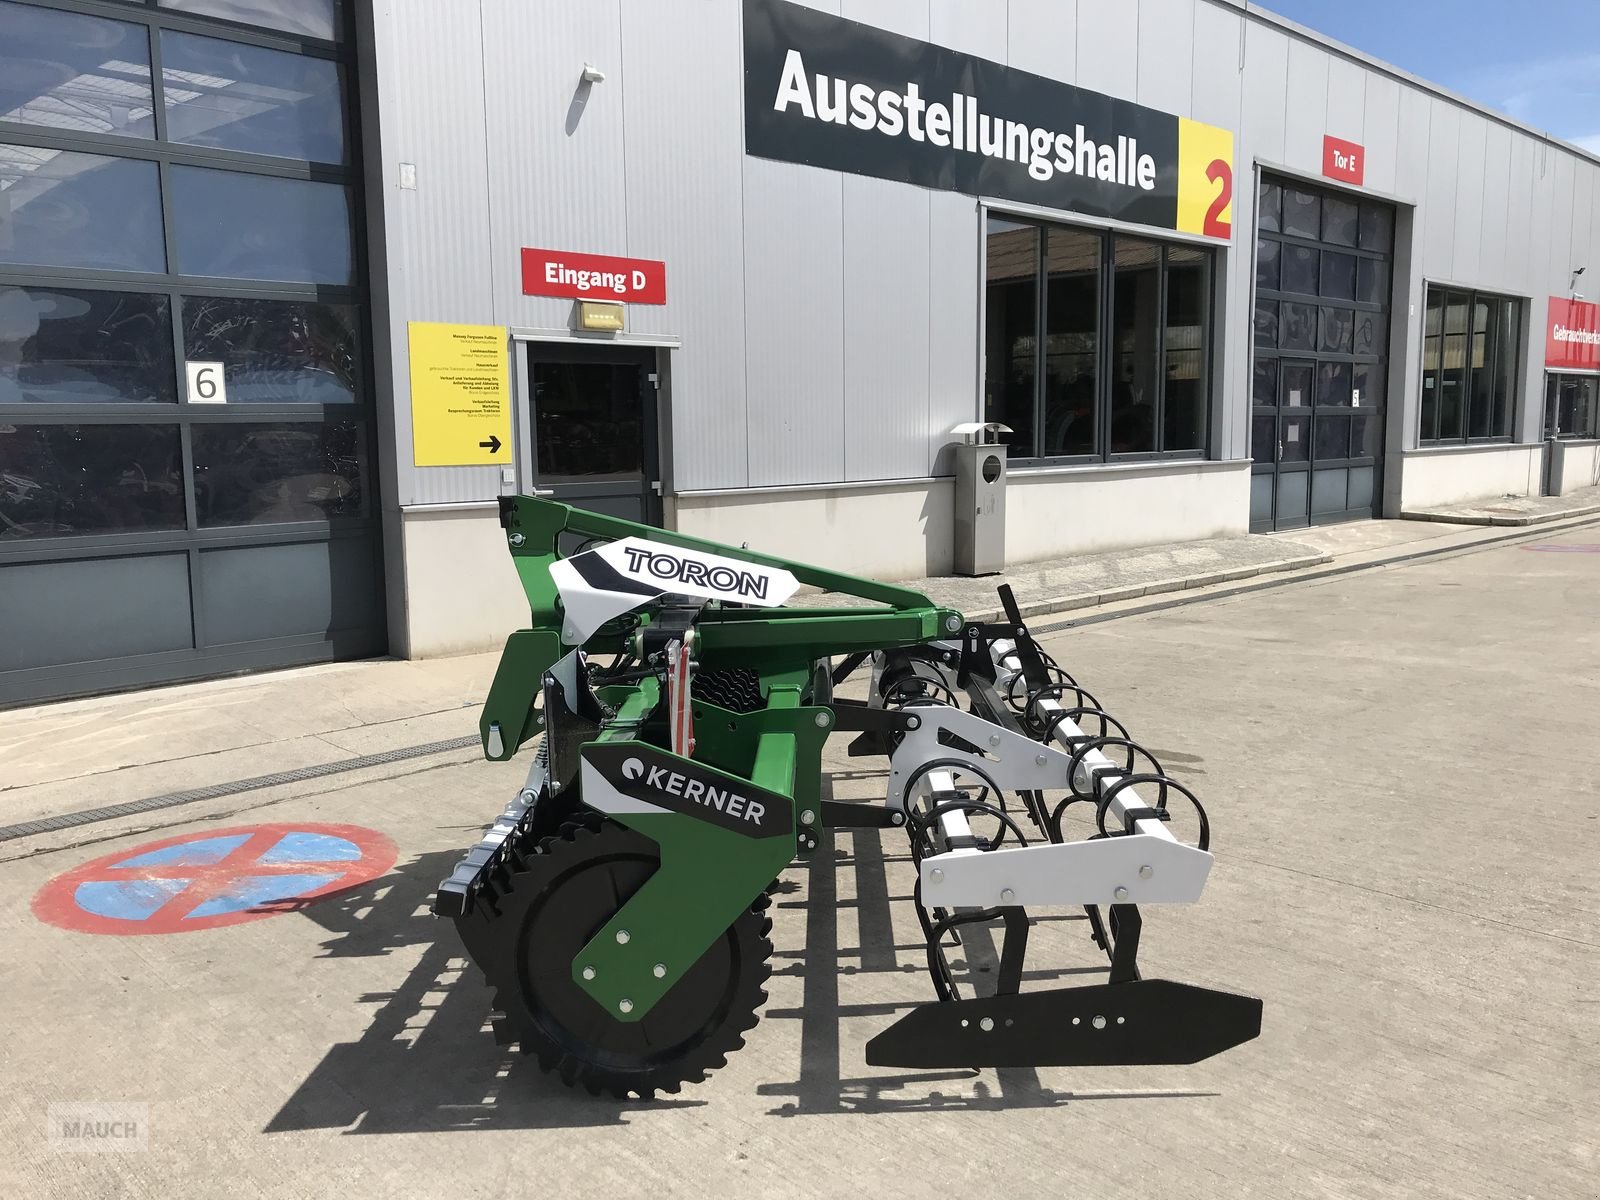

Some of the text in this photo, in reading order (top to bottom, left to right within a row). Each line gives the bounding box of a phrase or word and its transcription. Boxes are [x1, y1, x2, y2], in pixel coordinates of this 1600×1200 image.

[774, 49, 1232, 240] Ausstellungshalle 2
[1334, 150, 1356, 172] Tor E
[544, 262, 646, 293] Eingang D
[196, 368, 216, 398] 6
[624, 546, 768, 600] TORON
[646, 765, 766, 825] KERNER
